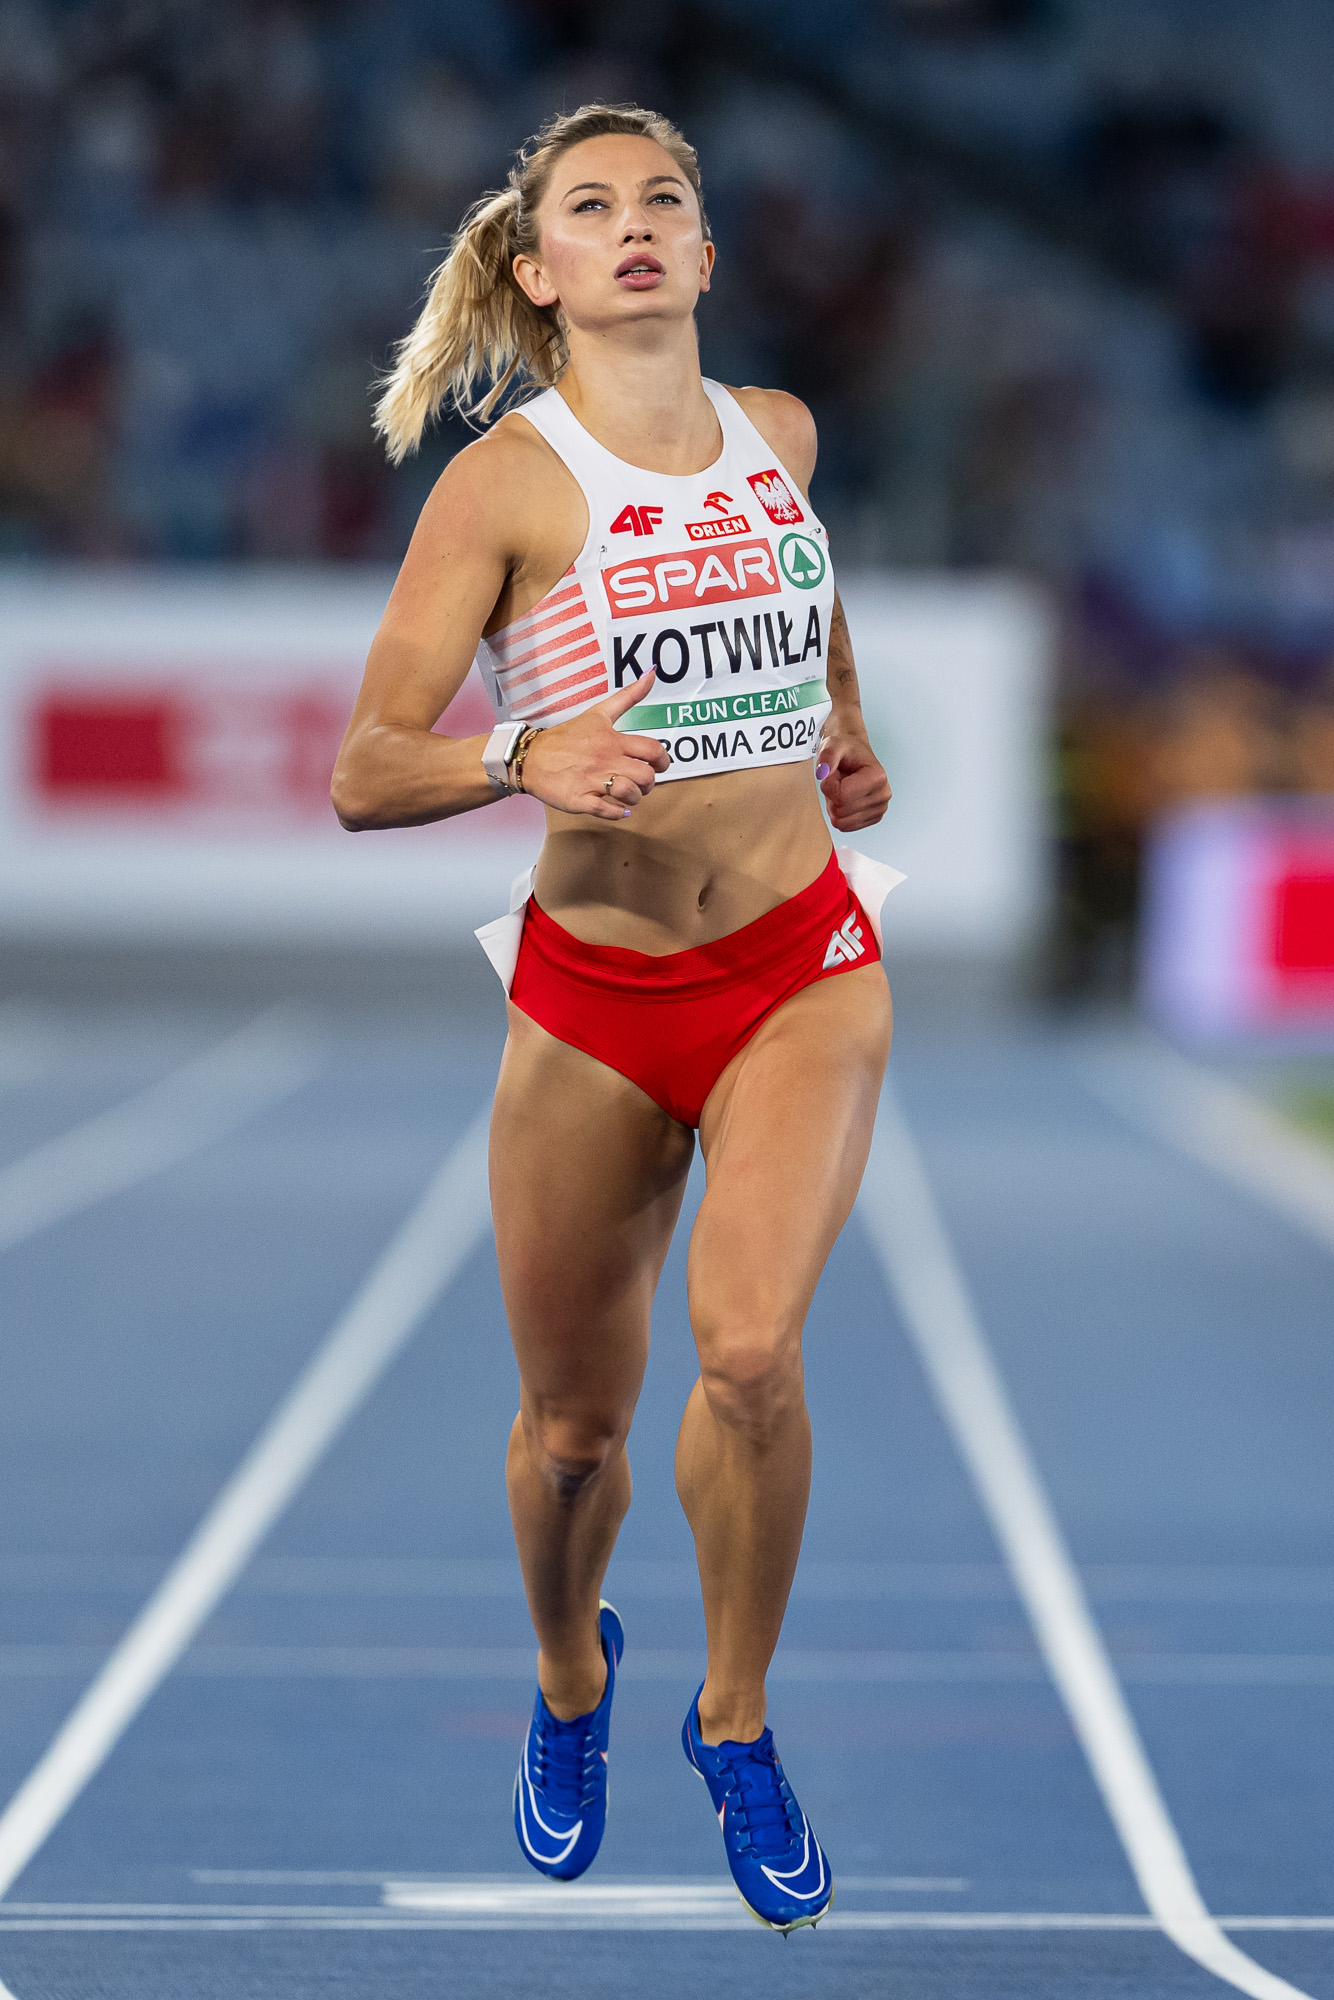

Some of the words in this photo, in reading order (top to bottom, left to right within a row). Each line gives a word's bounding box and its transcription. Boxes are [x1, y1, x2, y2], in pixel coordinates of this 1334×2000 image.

[610, 504, 663, 536] 4F
[691, 518, 747, 539] ORLEN
[609, 547, 775, 609] SPAR
[613, 605, 822, 688] KOTWIŁA
[666, 707, 672, 725] I
[679, 699, 728, 723] RUN
[760, 716, 816, 752] 2024
[822, 910, 865, 970] 4F
